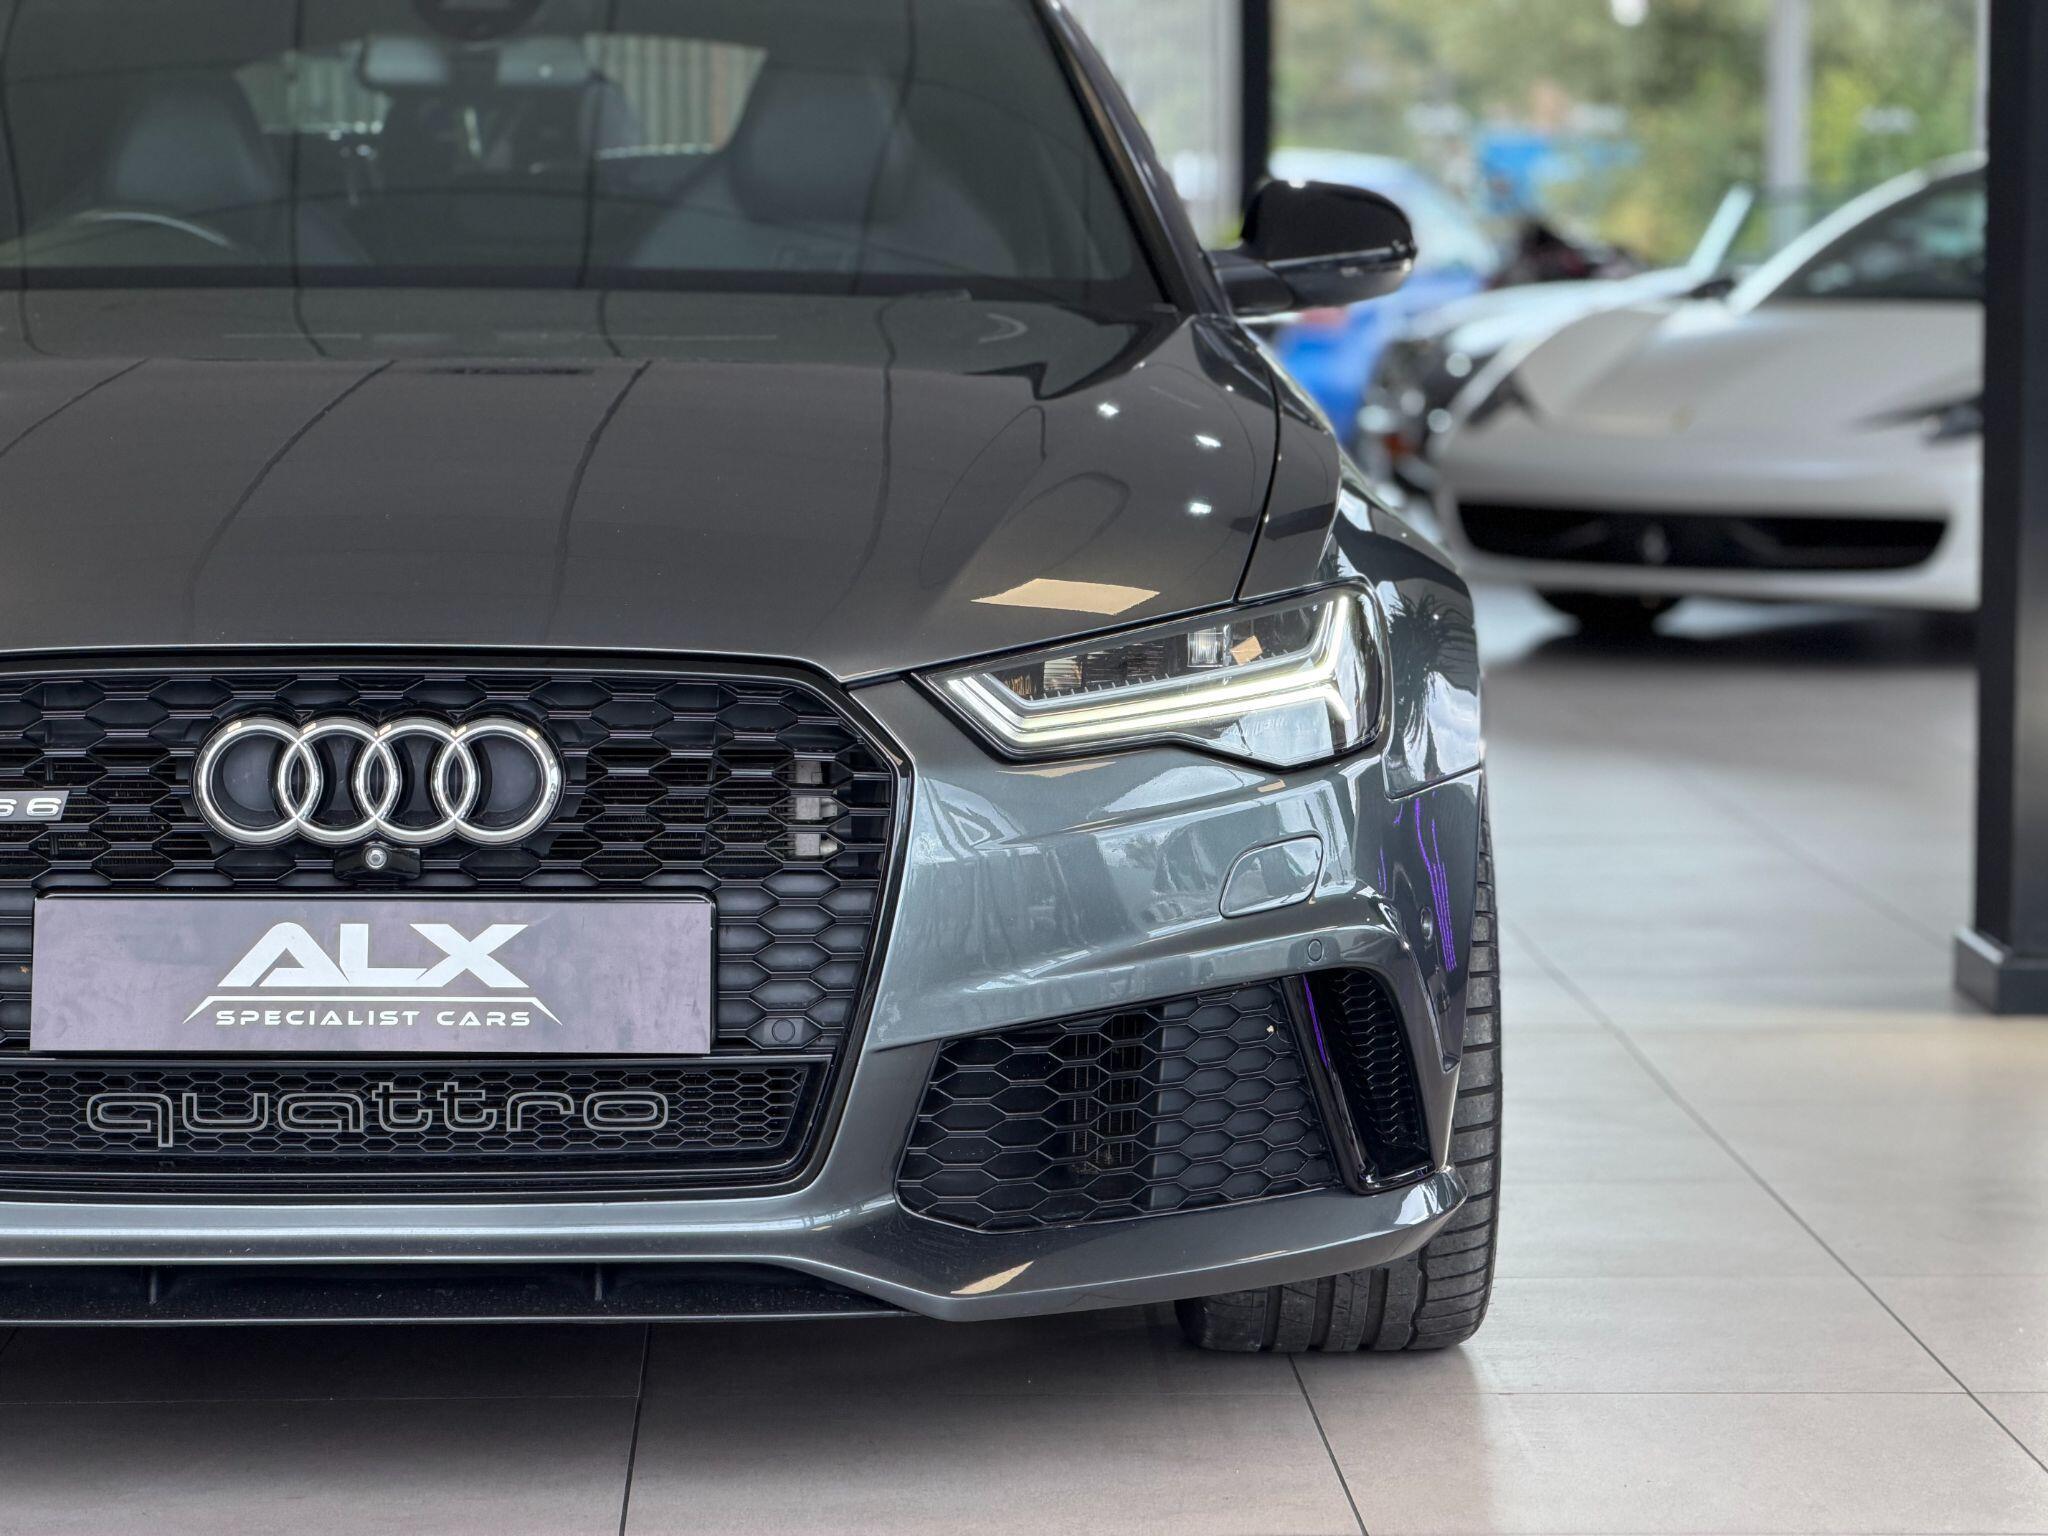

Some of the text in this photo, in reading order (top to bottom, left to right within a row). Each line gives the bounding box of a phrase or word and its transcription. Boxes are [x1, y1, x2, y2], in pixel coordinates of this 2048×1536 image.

[217, 921, 530, 988] ALX
[215, 1010, 531, 1027] SPECIALIST CARS
[86, 1081, 669, 1148] quattro
